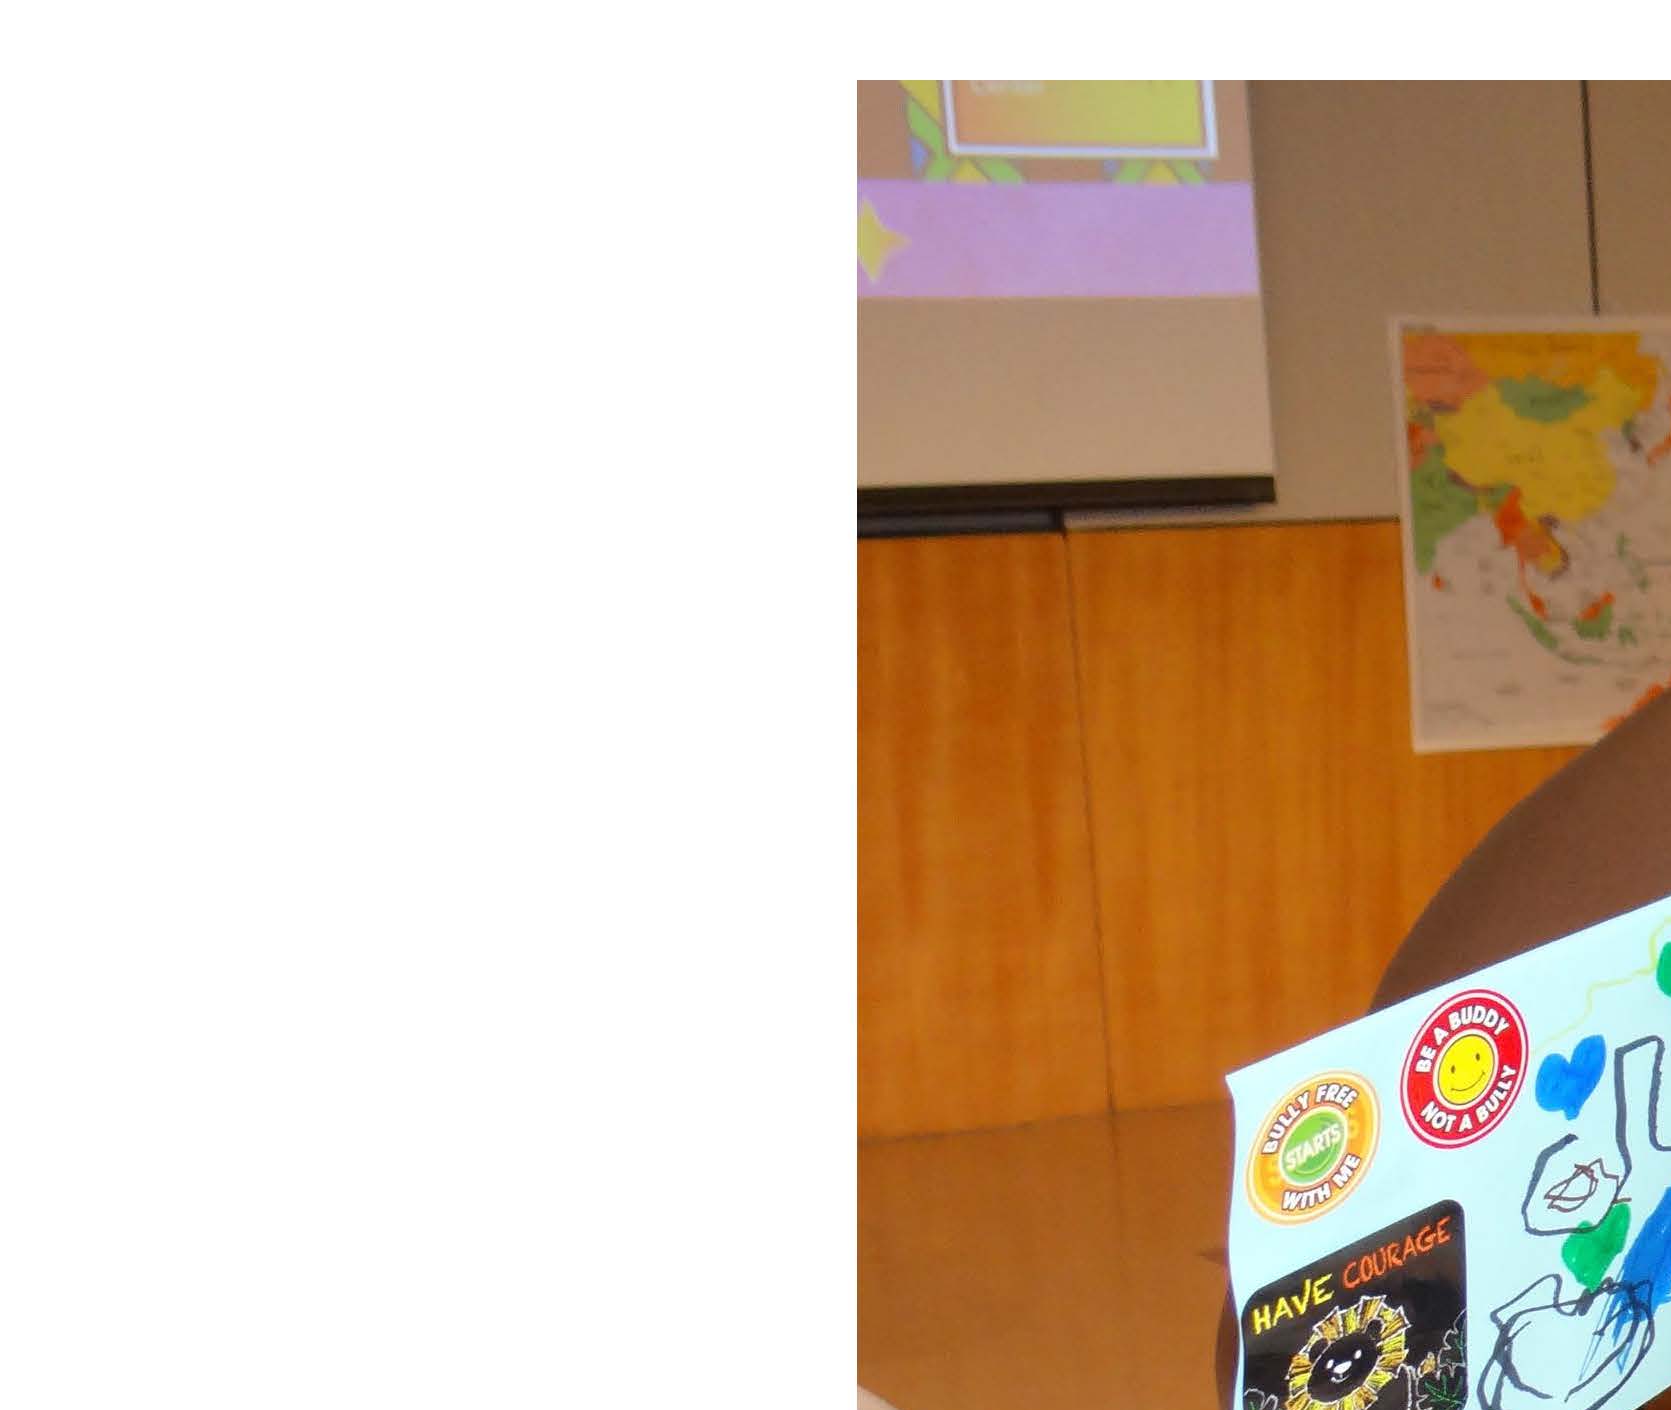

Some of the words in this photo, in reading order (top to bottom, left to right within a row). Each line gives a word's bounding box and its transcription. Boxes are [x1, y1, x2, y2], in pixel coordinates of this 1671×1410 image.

[1416, 1045, 1436, 1073] BE
[1433, 1026, 1449, 1046] A
[1448, 1005, 1509, 1036] BUDDY
[1262, 1086, 1309, 1154] BULLY
[1316, 1083, 1359, 1110] FREE
[1421, 1101, 1457, 1133] NOT
[1458, 1114, 1473, 1133] A
[1476, 1064, 1517, 1123] BULLY
[1285, 1123, 1342, 1170] STARTS
[1281, 1184, 1332, 1211] WITH
[1332, 1154, 1361, 1188] ME
[1252, 1273, 1336, 1335] HAVE
[1343, 1216, 1452, 1289] COURAGE
